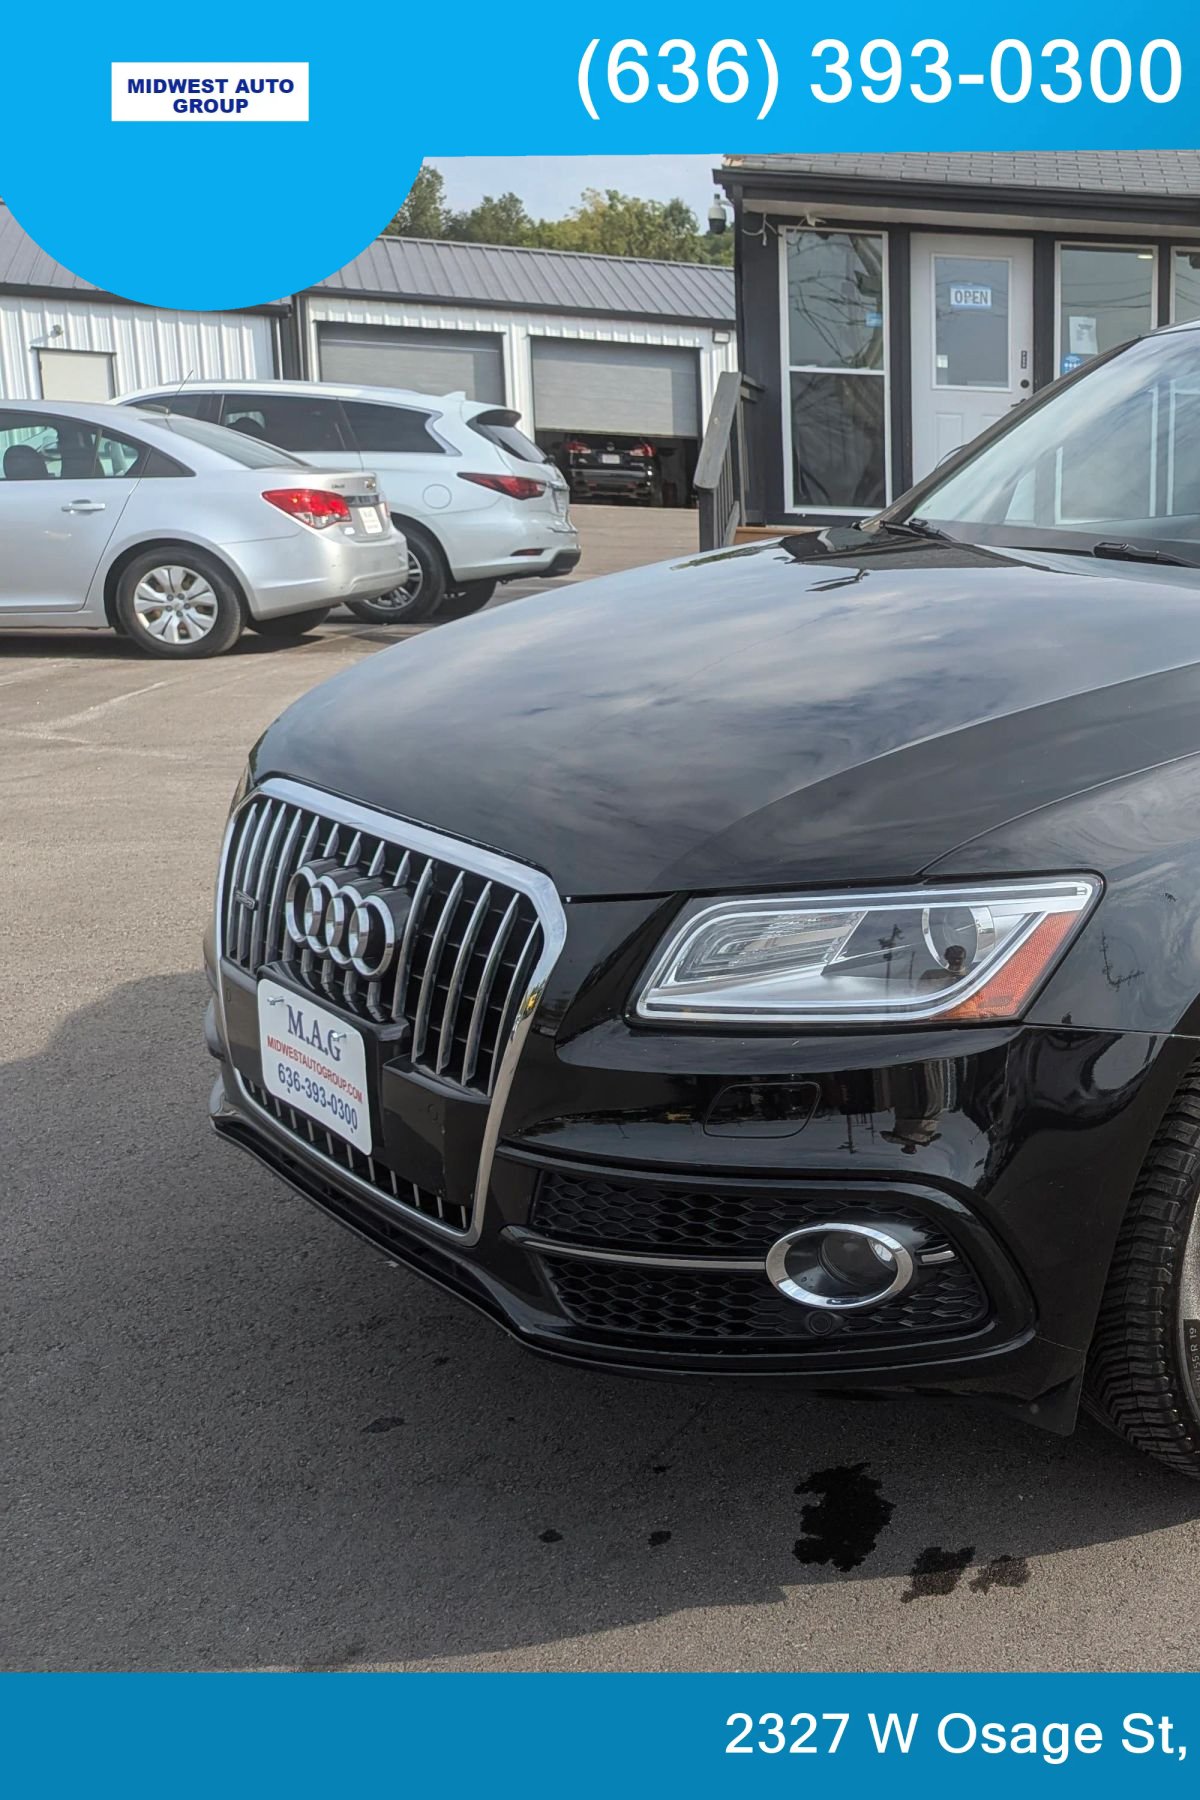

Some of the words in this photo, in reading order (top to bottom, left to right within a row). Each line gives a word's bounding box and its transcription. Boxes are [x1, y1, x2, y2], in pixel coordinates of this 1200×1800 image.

[954, 290, 989, 305] OPEN
[267, 1035, 363, 1104] MIDWESTAUTOGROUP.COM
[278, 1062, 358, 1131] 636-393-0300
